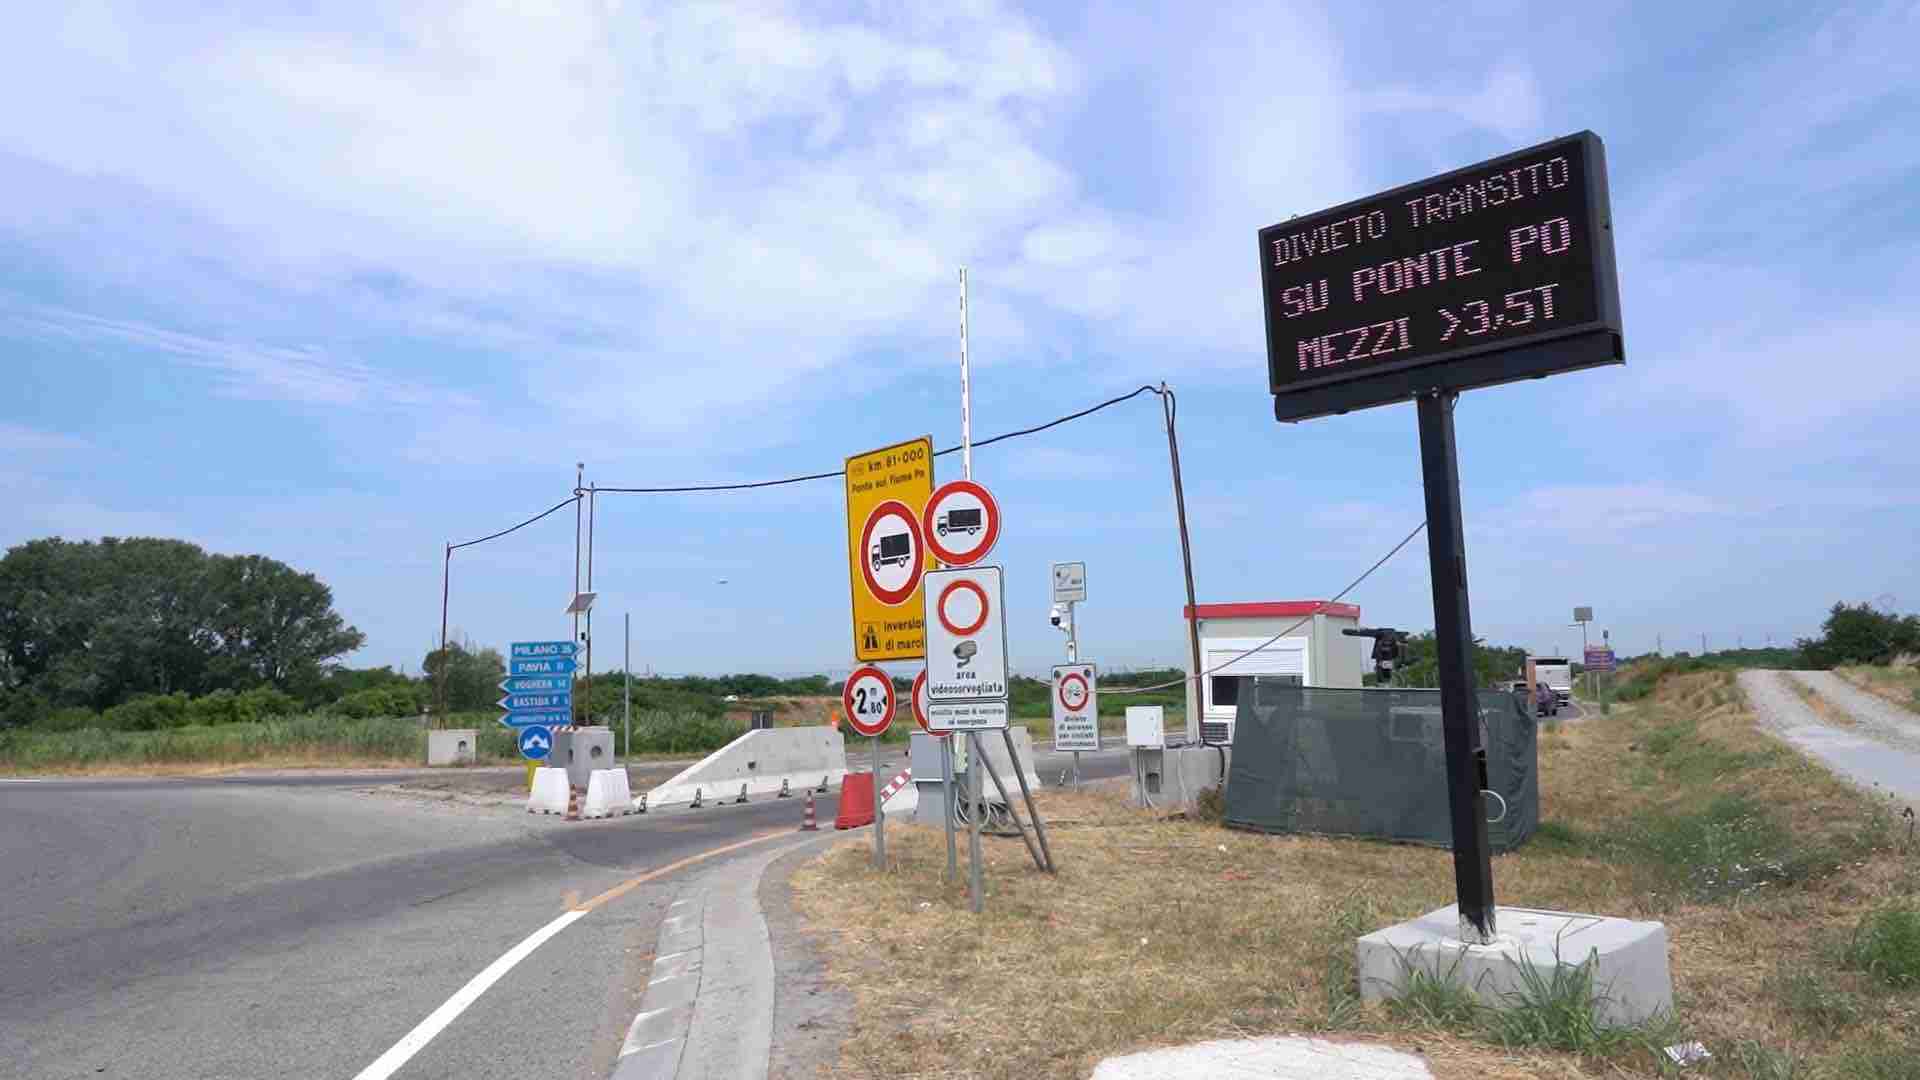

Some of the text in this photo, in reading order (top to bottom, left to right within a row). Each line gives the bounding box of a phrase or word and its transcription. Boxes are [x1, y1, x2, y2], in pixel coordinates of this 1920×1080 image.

[1272, 156, 1569, 267] DIVIETO TRANSITO
[1281, 216, 1571, 318] SU PONTE PO
[1297, 316, 1413, 371] MEZZI
[868, 460, 881, 473] km
[914, 469, 925, 479] Po
[514, 645, 558, 654] MILANO
[885, 638, 895, 650] di
[518, 662, 552, 673] PAVIA
[956, 672, 977, 680] area
[931, 682, 1003, 695] videosorvegliata
[857, 687, 867, 714] 2
[870, 702, 882, 714] 80
